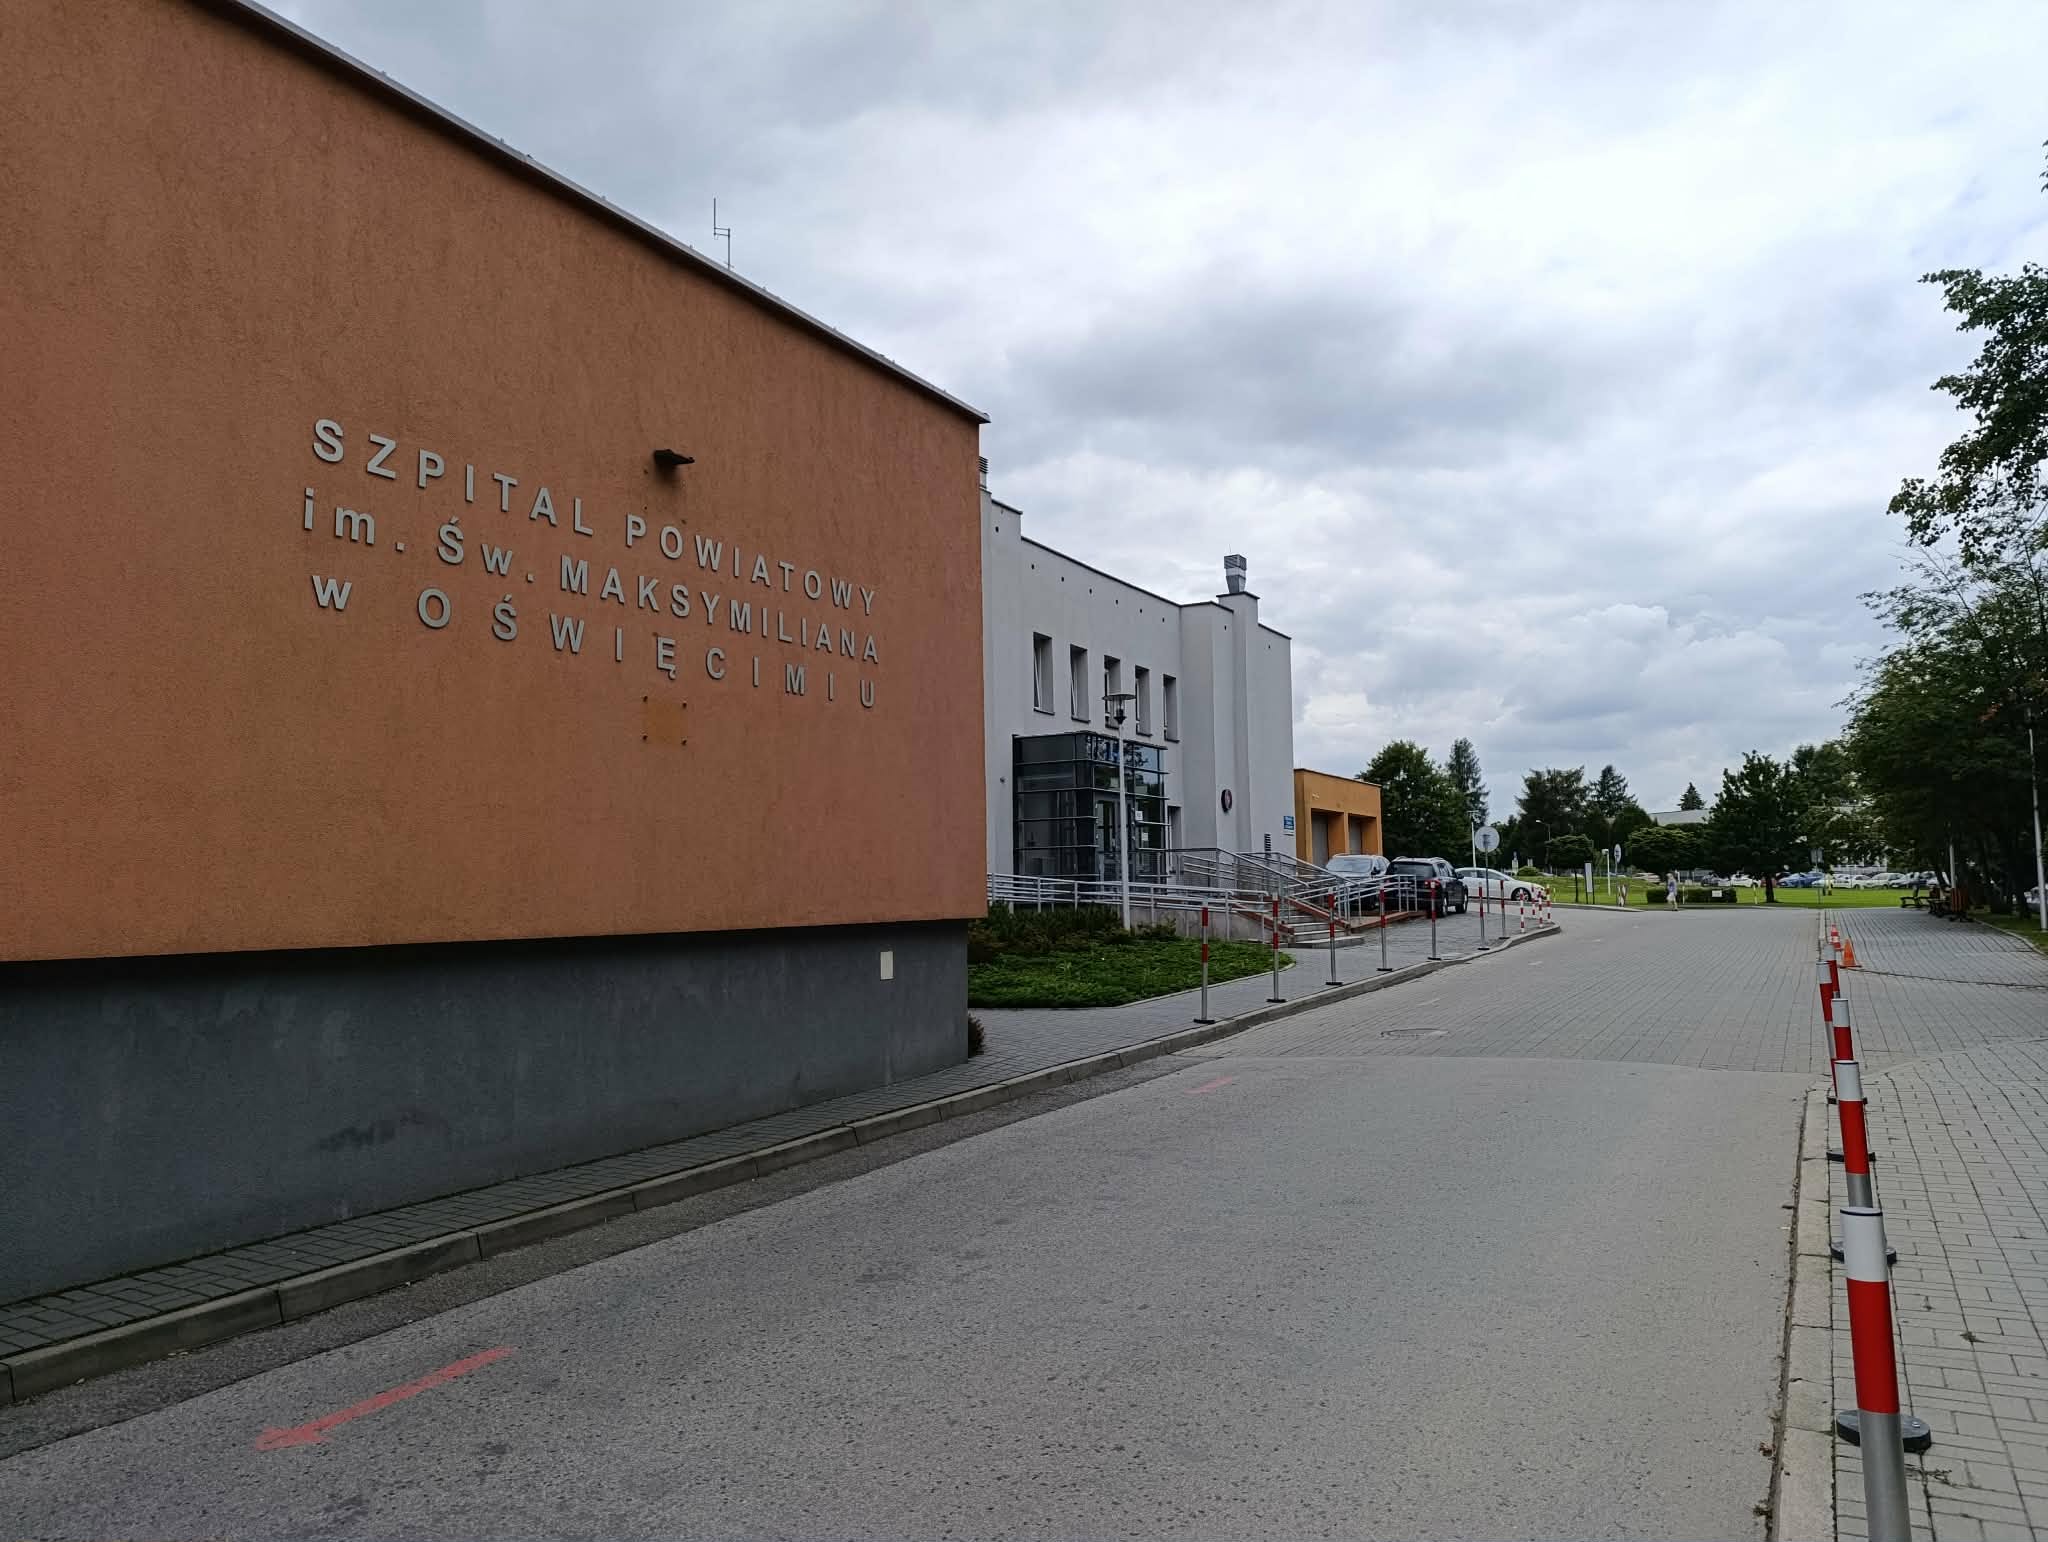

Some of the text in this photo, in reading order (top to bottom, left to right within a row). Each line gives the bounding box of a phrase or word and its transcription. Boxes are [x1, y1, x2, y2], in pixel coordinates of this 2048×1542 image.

[304, 487, 879, 663] im. Św. MAKSYMILIANA
[313, 418, 875, 616] SZPITAL POWIATOWY
[312, 575, 875, 708] w OŚWIĘCIMIU
